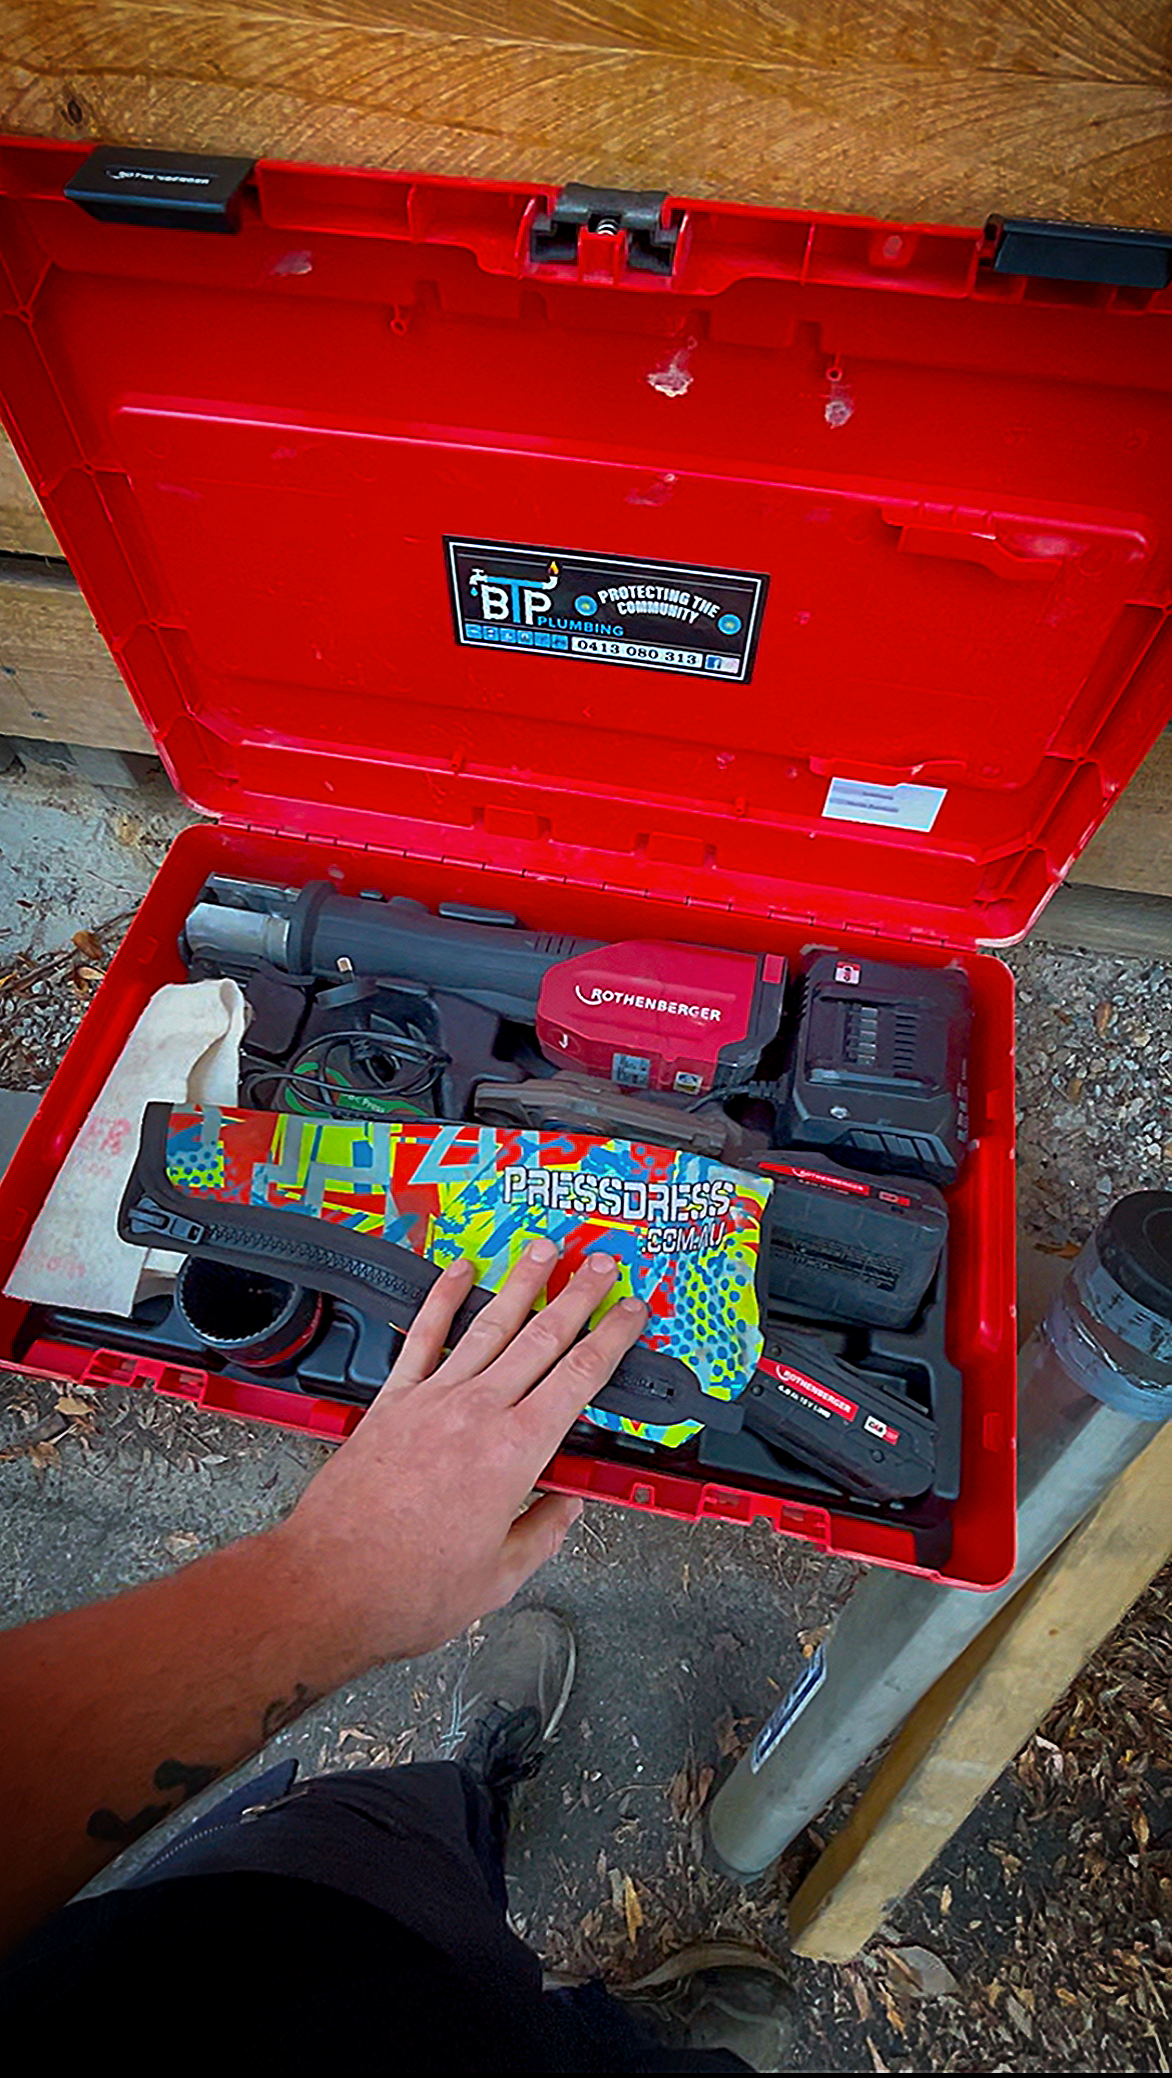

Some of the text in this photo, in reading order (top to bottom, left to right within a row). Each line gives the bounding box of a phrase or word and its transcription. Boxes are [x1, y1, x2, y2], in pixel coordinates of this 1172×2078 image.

[480, 576, 552, 625] BTP
[597, 585, 721, 619] PROTECTING THE
[616, 600, 700, 624] COMMUNITY
[537, 615, 625, 637] PLUMBING
[577, 640, 697, 665] 0413 080 313
[574, 984, 721, 1022] ROTHENBERGER
[503, 1165, 737, 1222] PRESSDRESS
[776, 1365, 853, 1414] ROTHENBERGER
